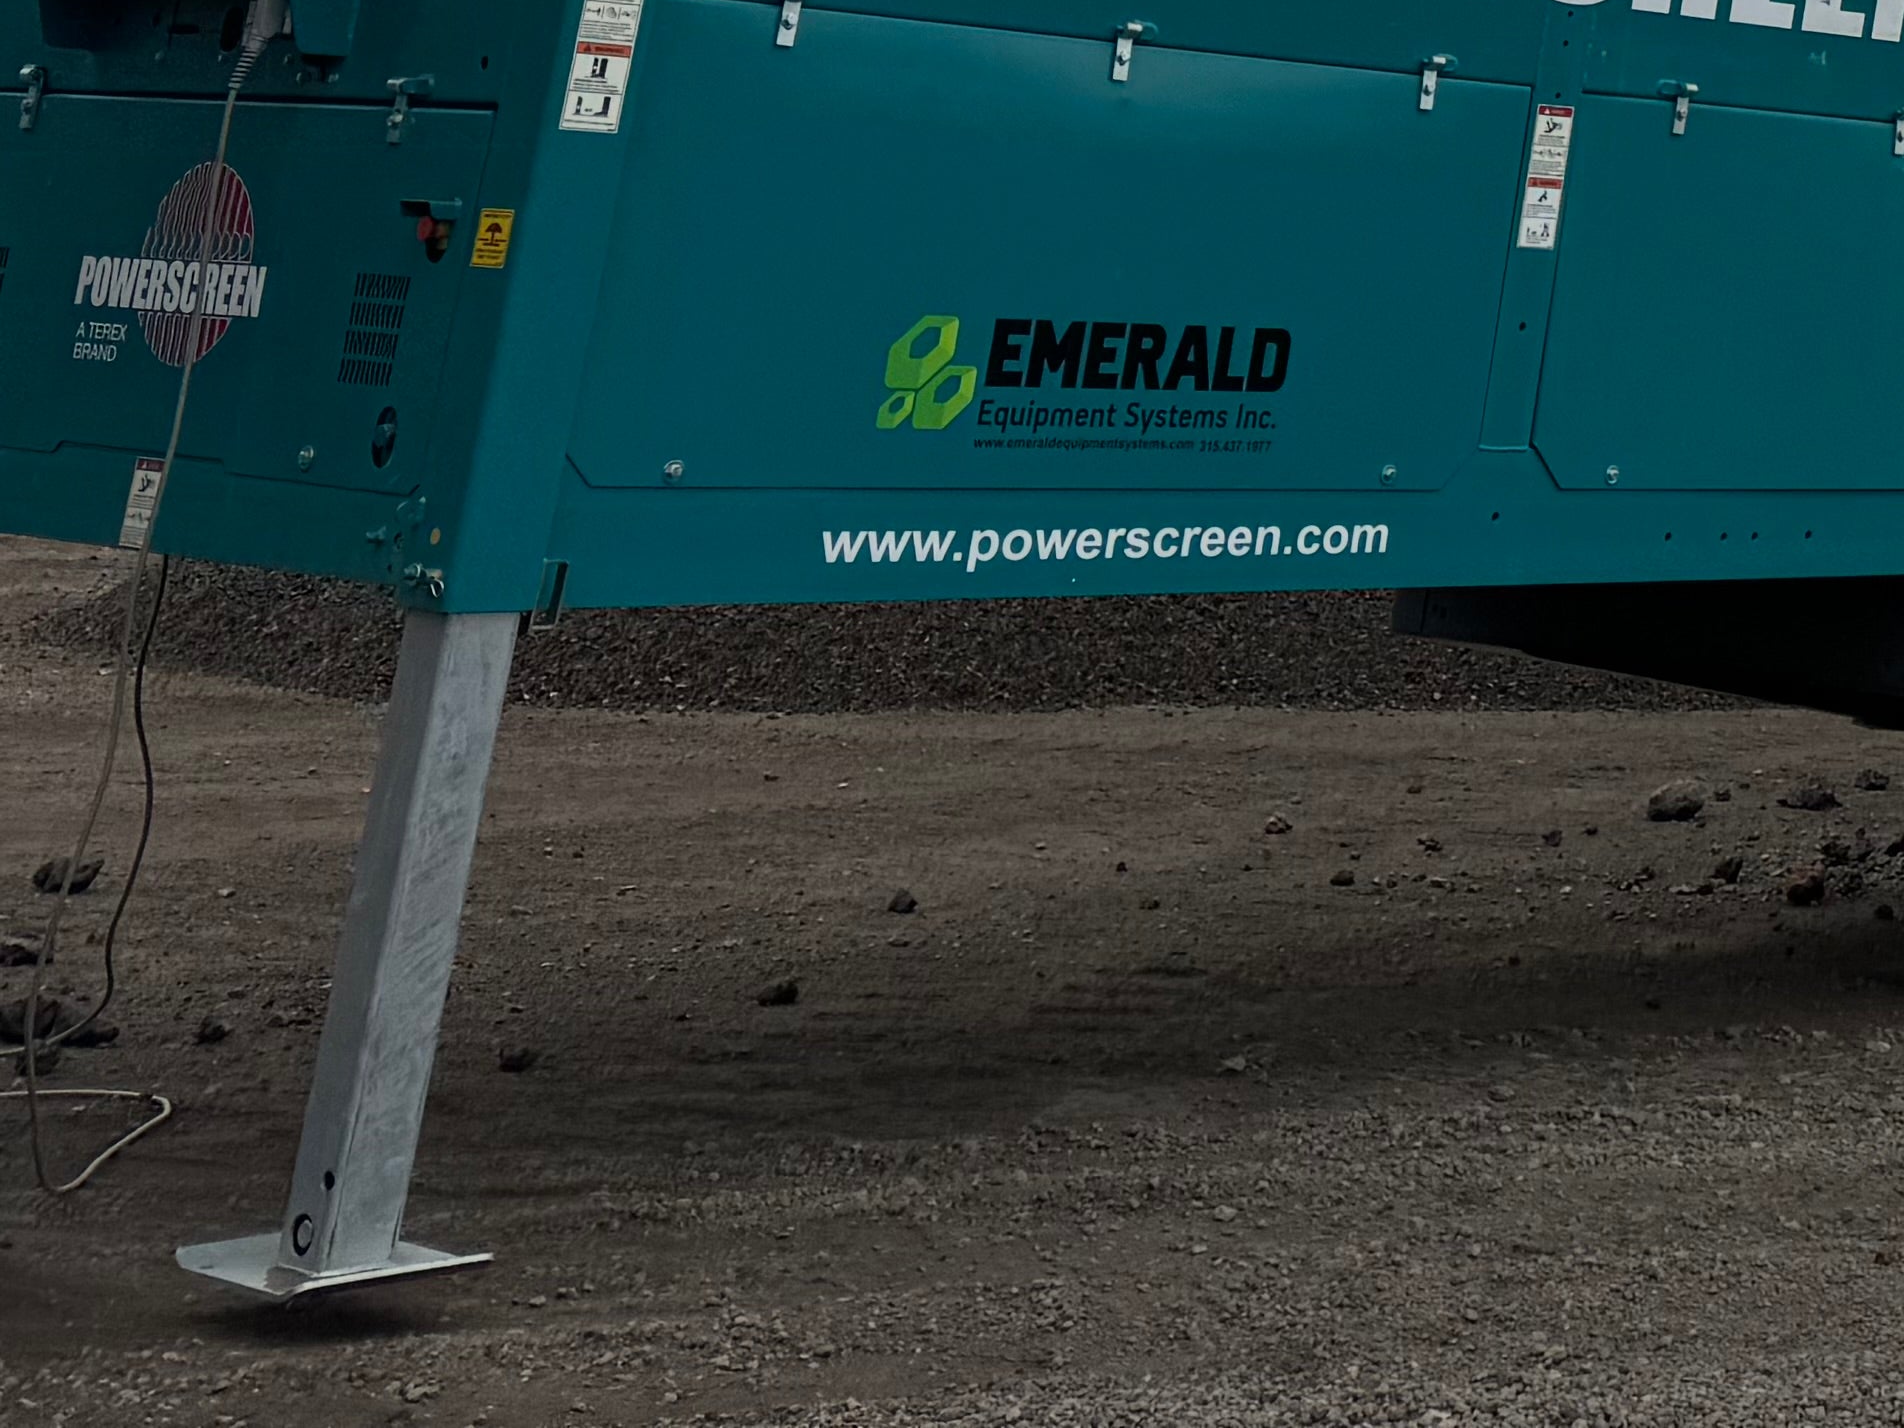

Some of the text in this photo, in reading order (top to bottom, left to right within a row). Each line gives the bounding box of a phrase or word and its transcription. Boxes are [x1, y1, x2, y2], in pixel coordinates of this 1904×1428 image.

[74, 255, 268, 318] POWERSCREEN
[72, 342, 117, 362] BRAND
[75, 321, 128, 342] A TEREX
[984, 318, 1292, 393] EMERALD
[977, 399, 1277, 435] Equipment Systems Inc.
[822, 523, 1389, 573] www.powerscreen.com
